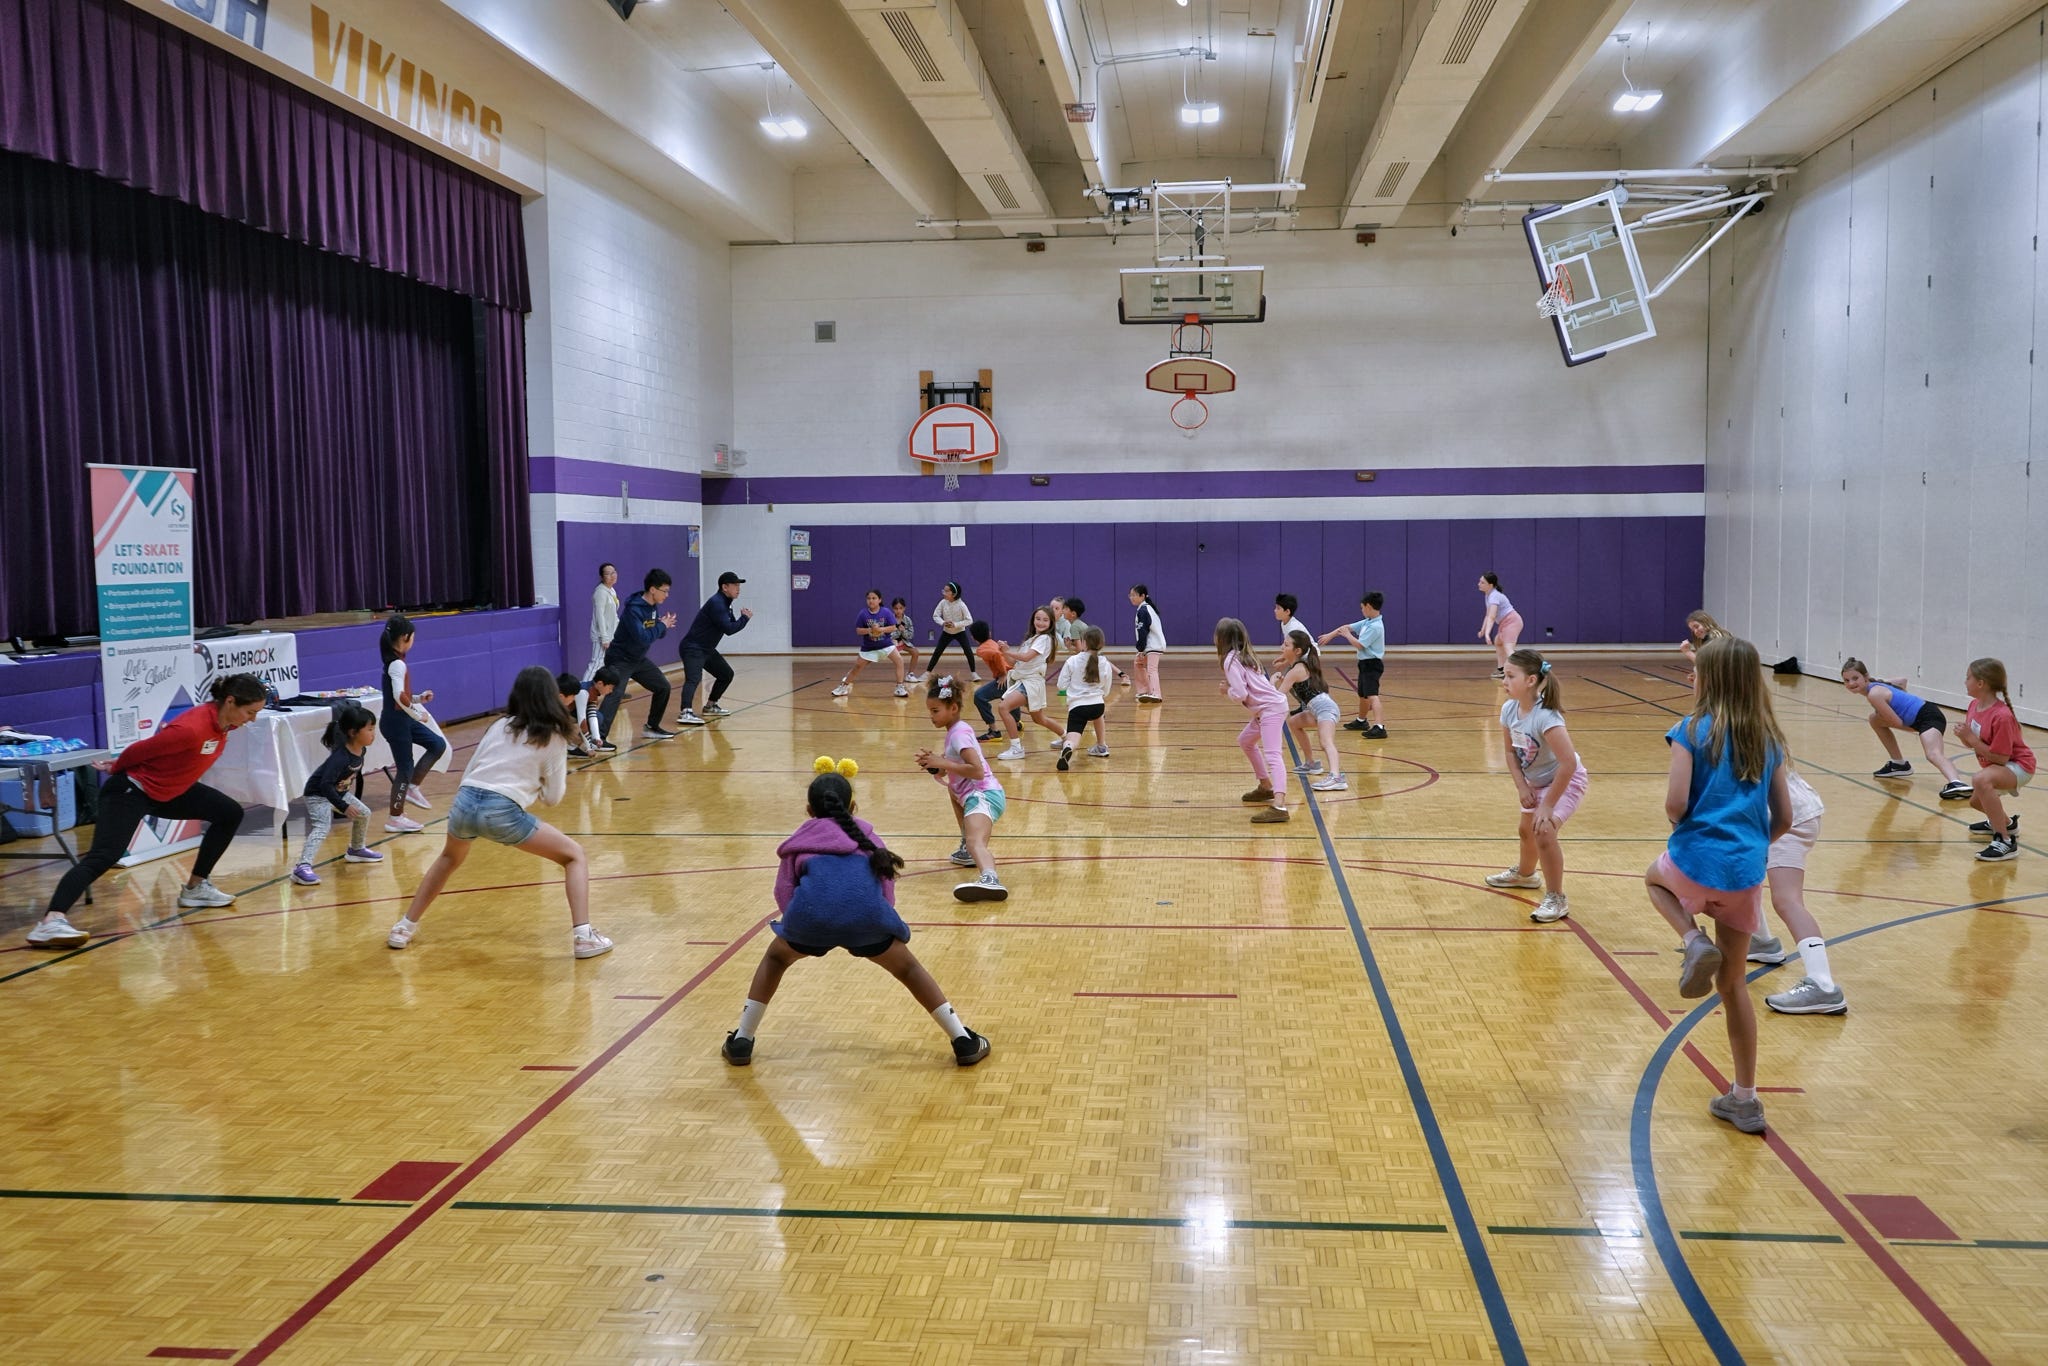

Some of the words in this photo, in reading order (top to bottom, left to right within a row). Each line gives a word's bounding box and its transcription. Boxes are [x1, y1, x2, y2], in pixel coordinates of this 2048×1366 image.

[311, 3, 503, 173] VIKINGS
[114, 544, 142, 556] LET'S
[143, 544, 180, 556] SKATE
[112, 562, 184, 575] FOUNDATION
[217, 647, 275, 669] ELMBROOK
[122, 659, 147, 685] Let's
